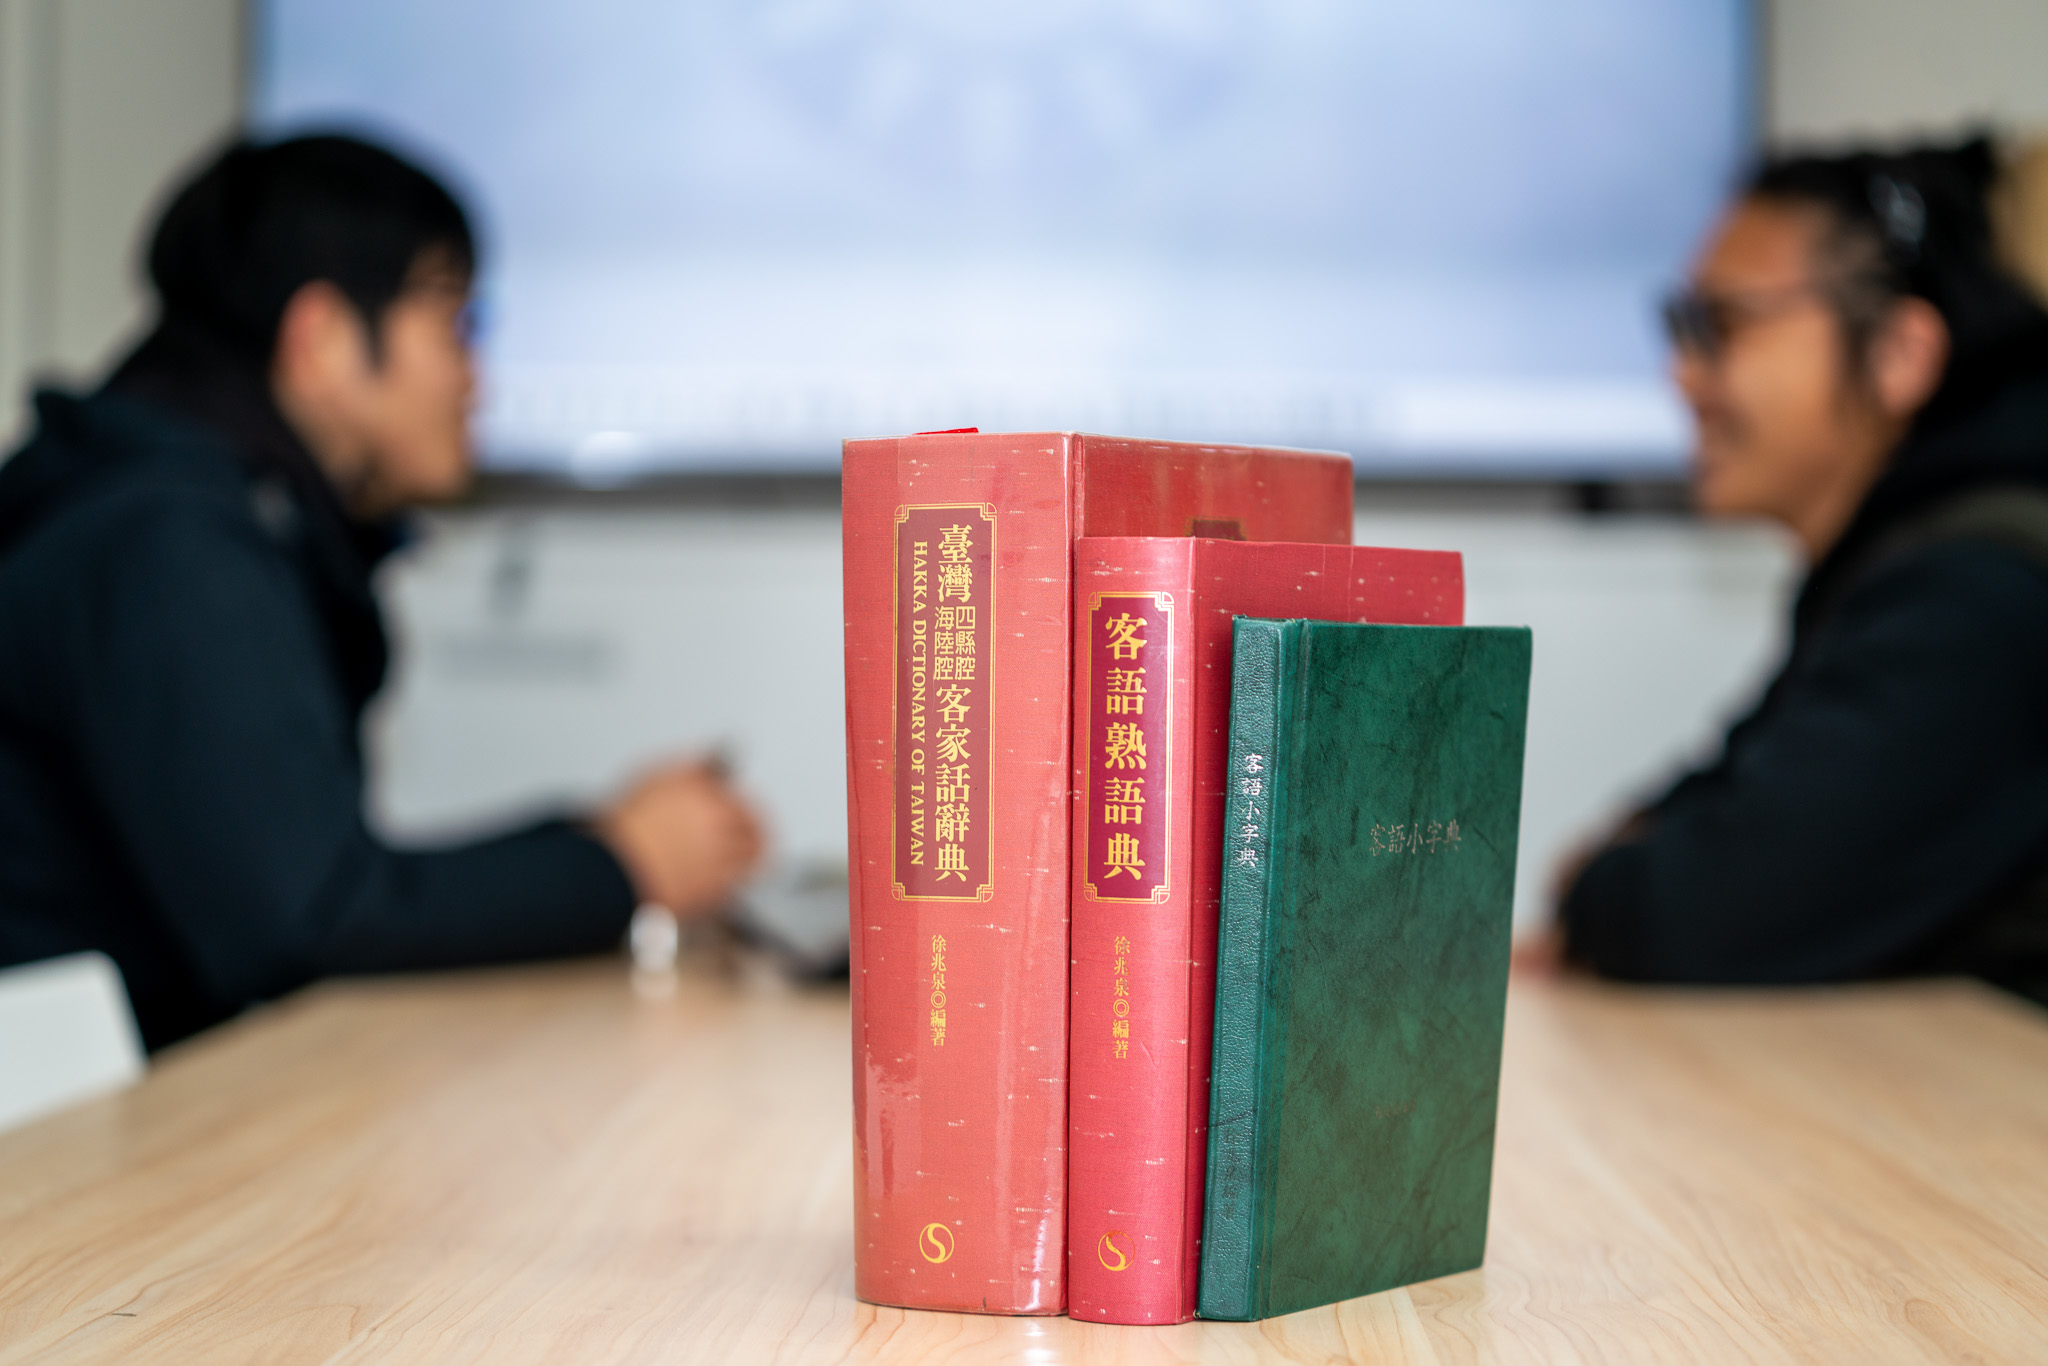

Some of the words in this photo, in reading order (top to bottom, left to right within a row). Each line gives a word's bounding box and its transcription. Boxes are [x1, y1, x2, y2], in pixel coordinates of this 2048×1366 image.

[913, 541, 928, 613] HAKKA
[938, 524, 973, 603] 臺灣
[911, 620, 927, 743] DICTIONARY
[933, 605, 954, 681] 海陸腔
[954, 605, 976, 681] 四縣腔
[911, 748, 926, 776] OF
[934, 683, 972, 883] 客家話辭典
[1104, 612, 1148, 881] 客語熟語典
[910, 781, 925, 866] TAIWAN
[1237, 752, 1264, 868] 客語小字典
[1369, 818, 1462, 856] 客語小字典
